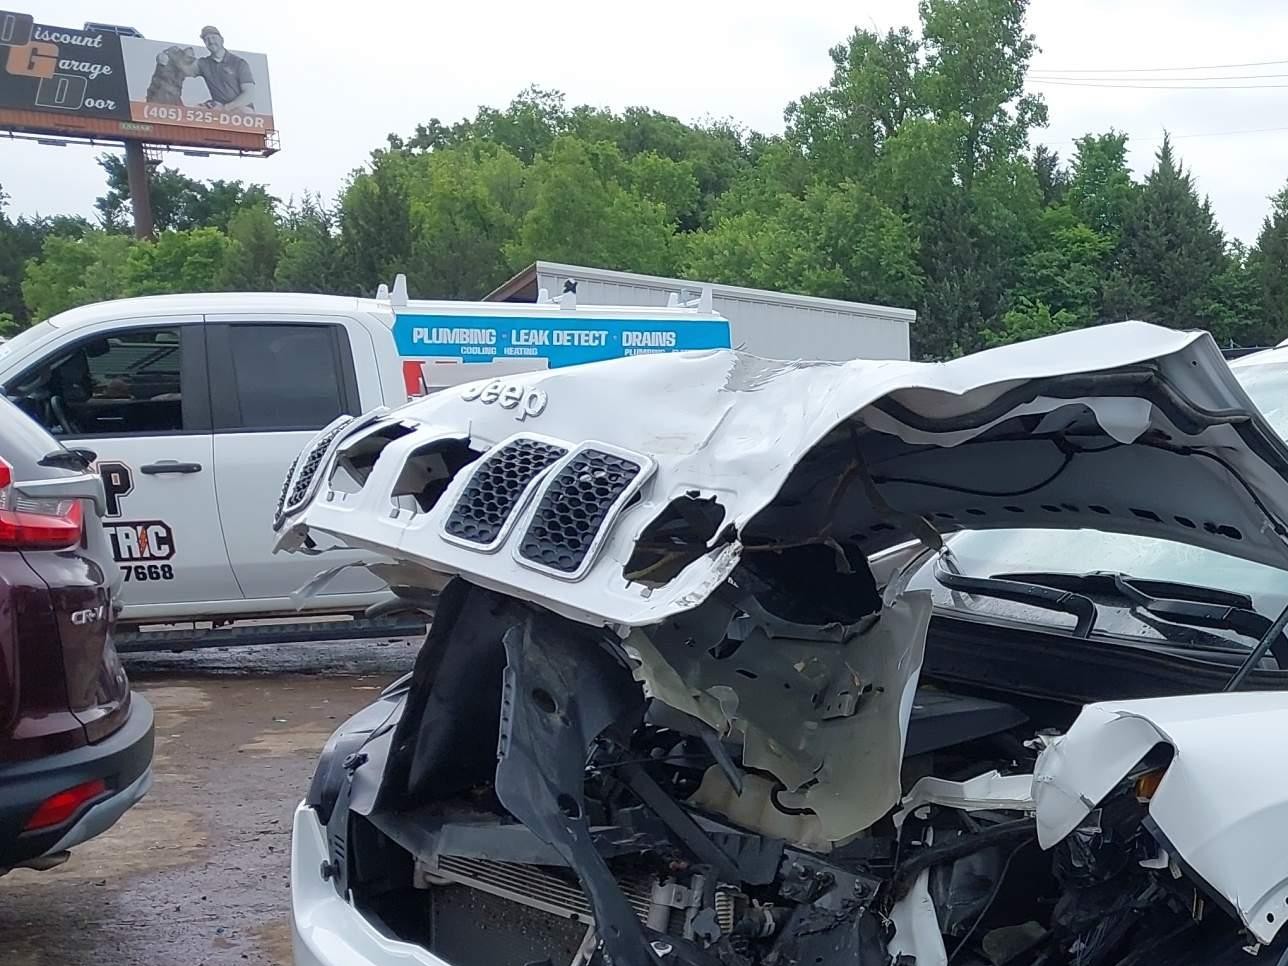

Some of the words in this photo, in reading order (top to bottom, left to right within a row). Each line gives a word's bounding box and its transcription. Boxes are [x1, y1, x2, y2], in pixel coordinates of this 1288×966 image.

[6, 41, 113, 80] Garage
[35, 73, 116, 110] Door
[143, 105, 183, 122] (405)
[186, 110, 265, 129] 525-DOOR
[412, 327, 497, 345] PLUMBING
[511, 329, 549, 345] LEAK
[552, 330, 609, 347] DETECT
[622, 331, 677, 347] DRAINS
[460, 346, 496, 355] COOLING
[503, 347, 538, 355] HEATING
[461, 378, 548, 423] Jeep
[119, 563, 174, 582] 7668
[71, 605, 105, 625] CR-V
